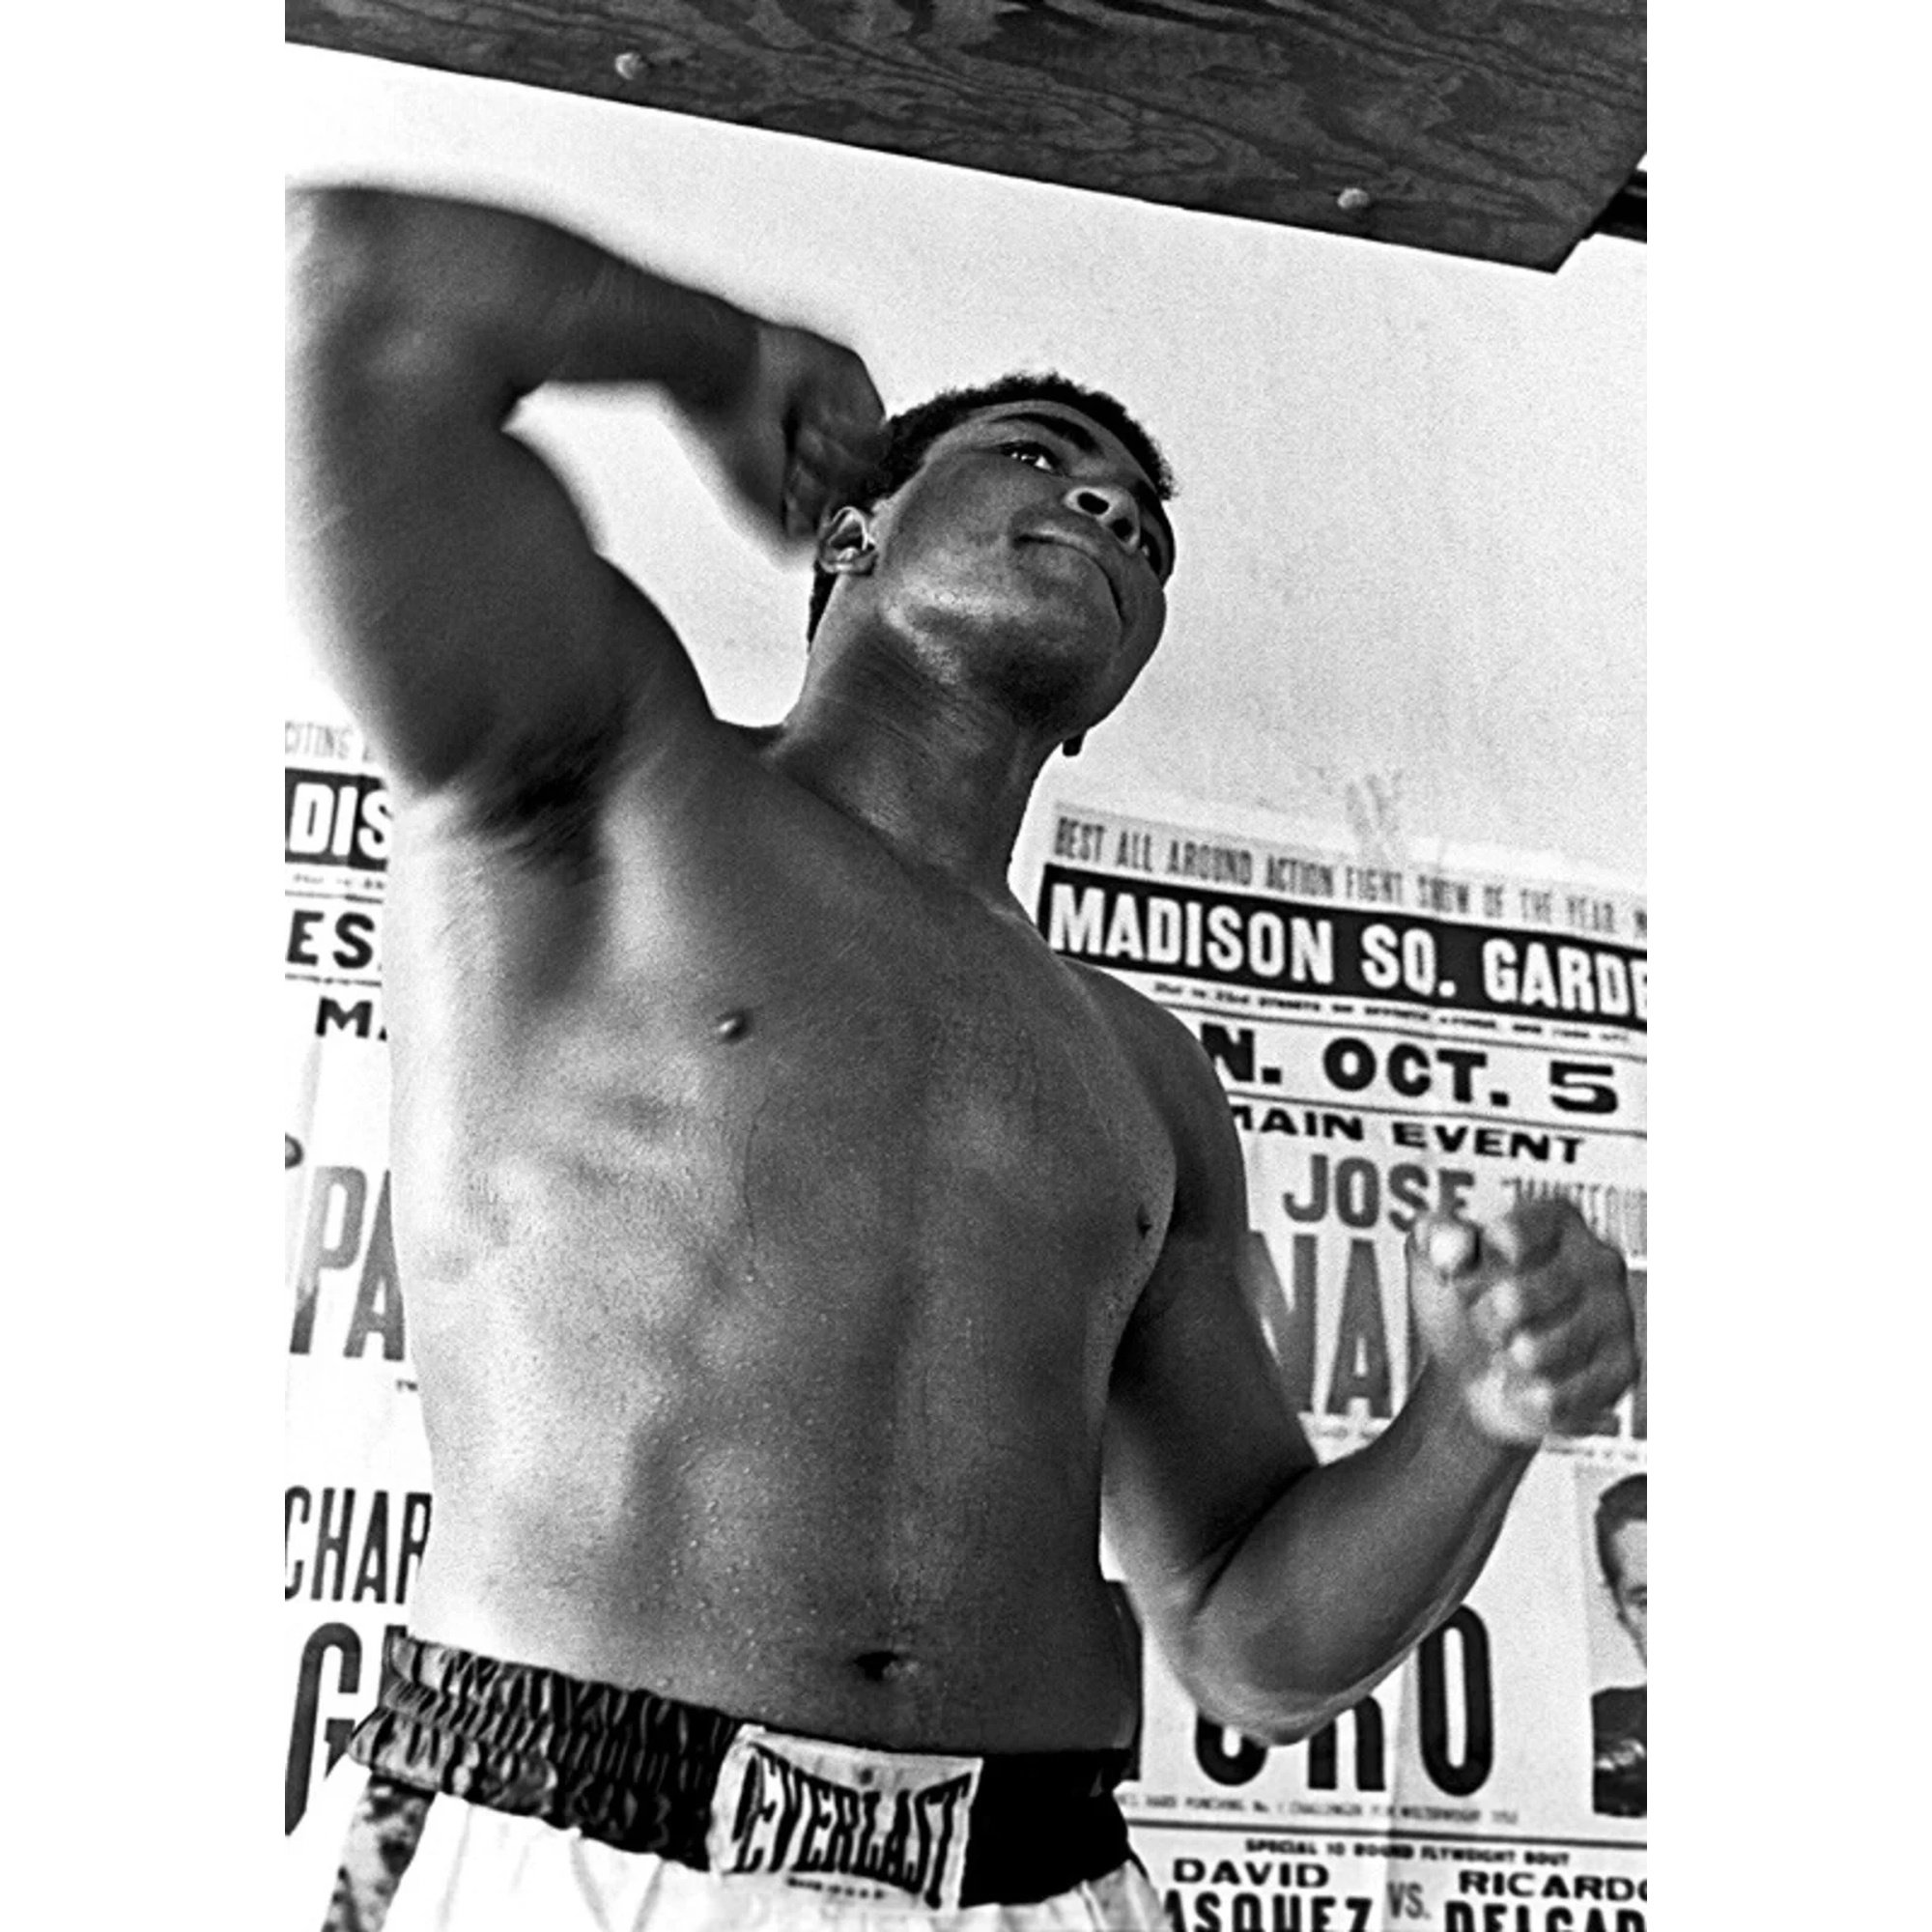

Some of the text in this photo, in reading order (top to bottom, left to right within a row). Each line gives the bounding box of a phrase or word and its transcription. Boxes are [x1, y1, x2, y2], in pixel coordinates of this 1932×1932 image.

[1056, 817, 1104, 862] BEST
[1117, 831, 1151, 873] ALL
[1168, 838, 1252, 887] AROUND
[1266, 854, 1335, 898] ACTION
[1346, 866, 1402, 906] FIGHT
[1520, 887, 1551, 924] THE
[1049, 883, 1334, 985] MADISON
[1361, 923, 1457, 997] SQ.
[1322, 1037, 1510, 1108] OCT.
[1549, 1060, 1619, 1115] 5
[1393, 1121, 1583, 1164] EVENT
[731, 1742, 972, 1910] EVERLAST
[1245, 1838, 1318, 1856] SPECIAL
[1173, 1858, 1329, 1888] DAVID
